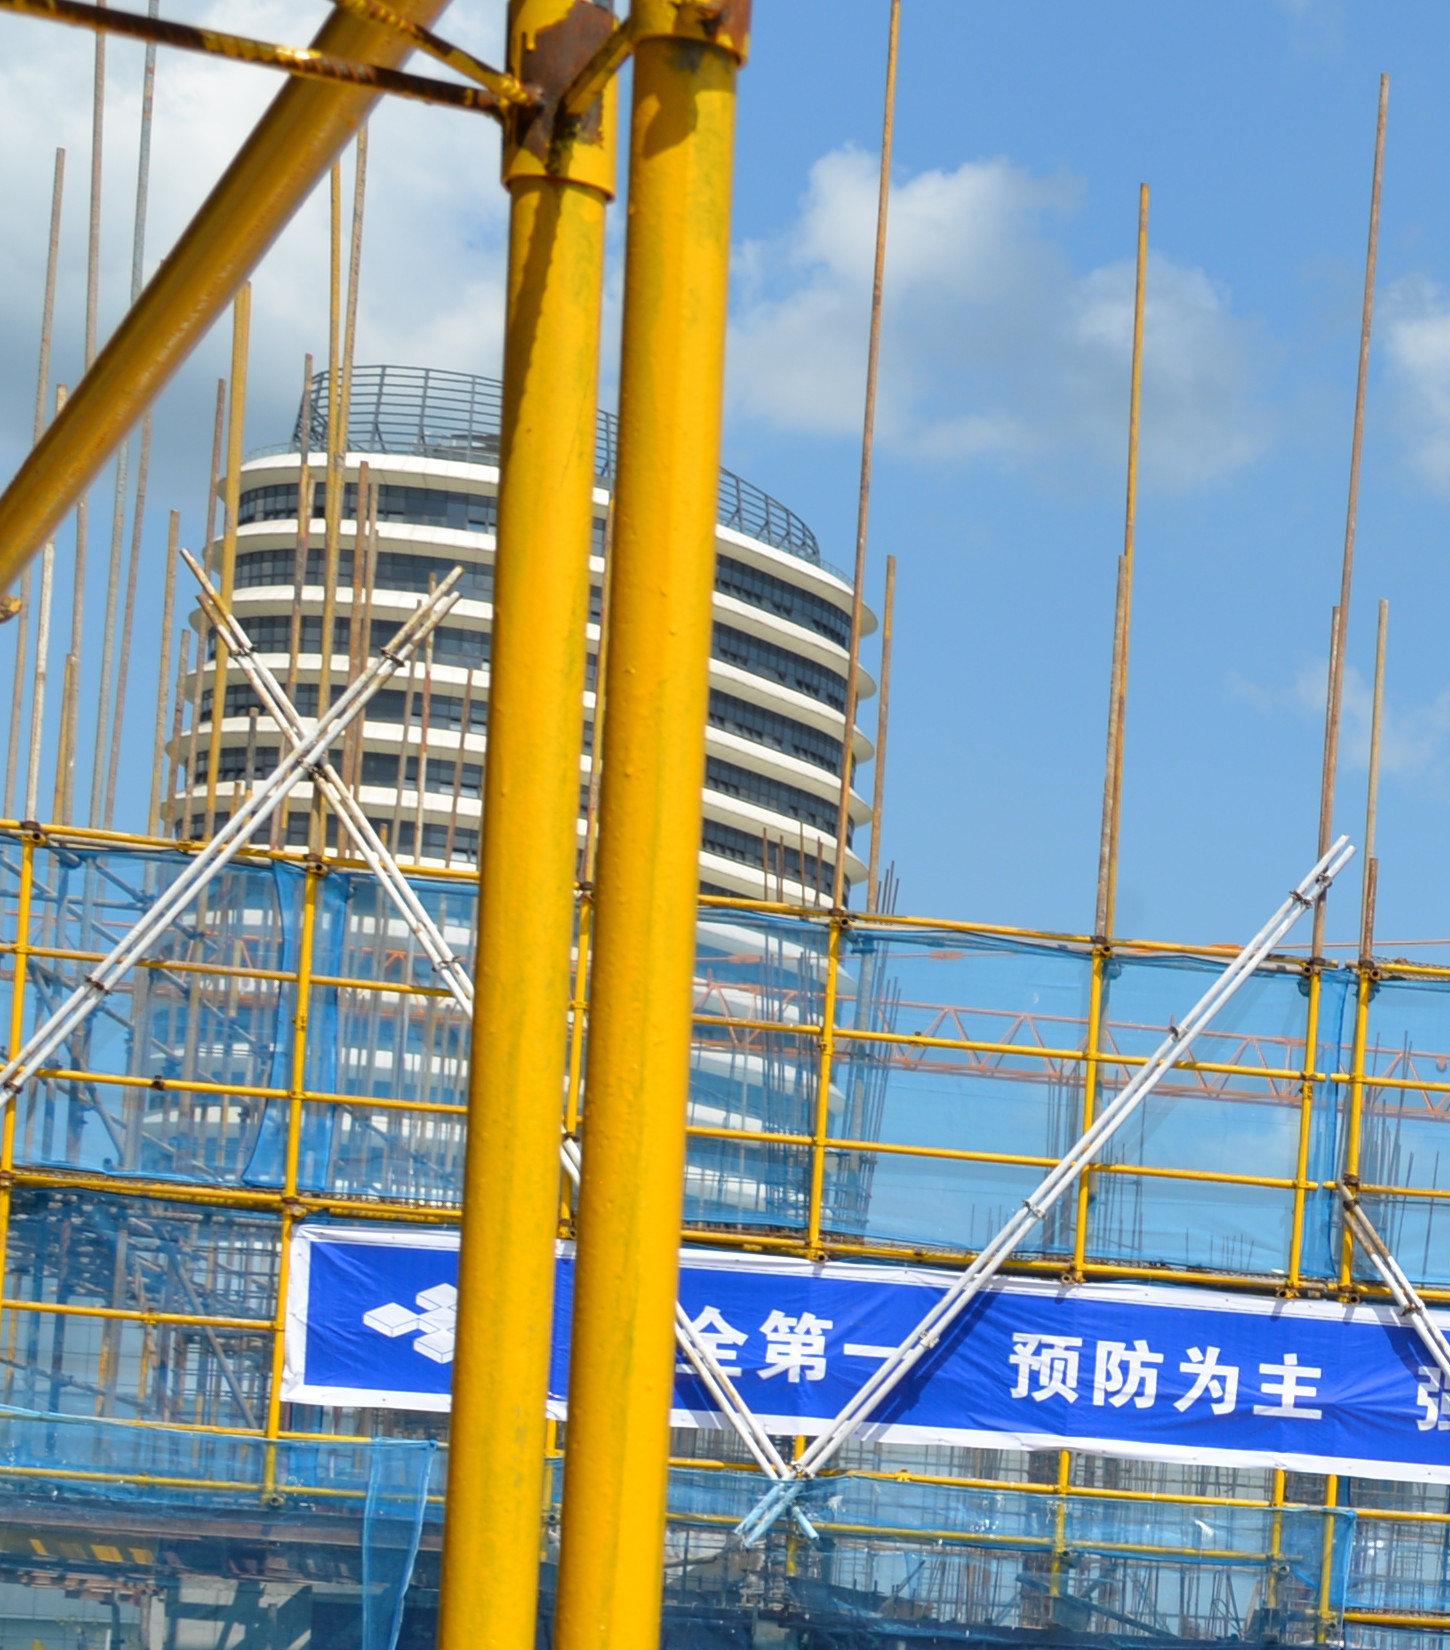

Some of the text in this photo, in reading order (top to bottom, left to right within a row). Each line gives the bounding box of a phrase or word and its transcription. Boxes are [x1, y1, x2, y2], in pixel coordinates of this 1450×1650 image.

[676, 1303, 902, 1386] 全第一
[1008, 1330, 1324, 1421] 预防为主
